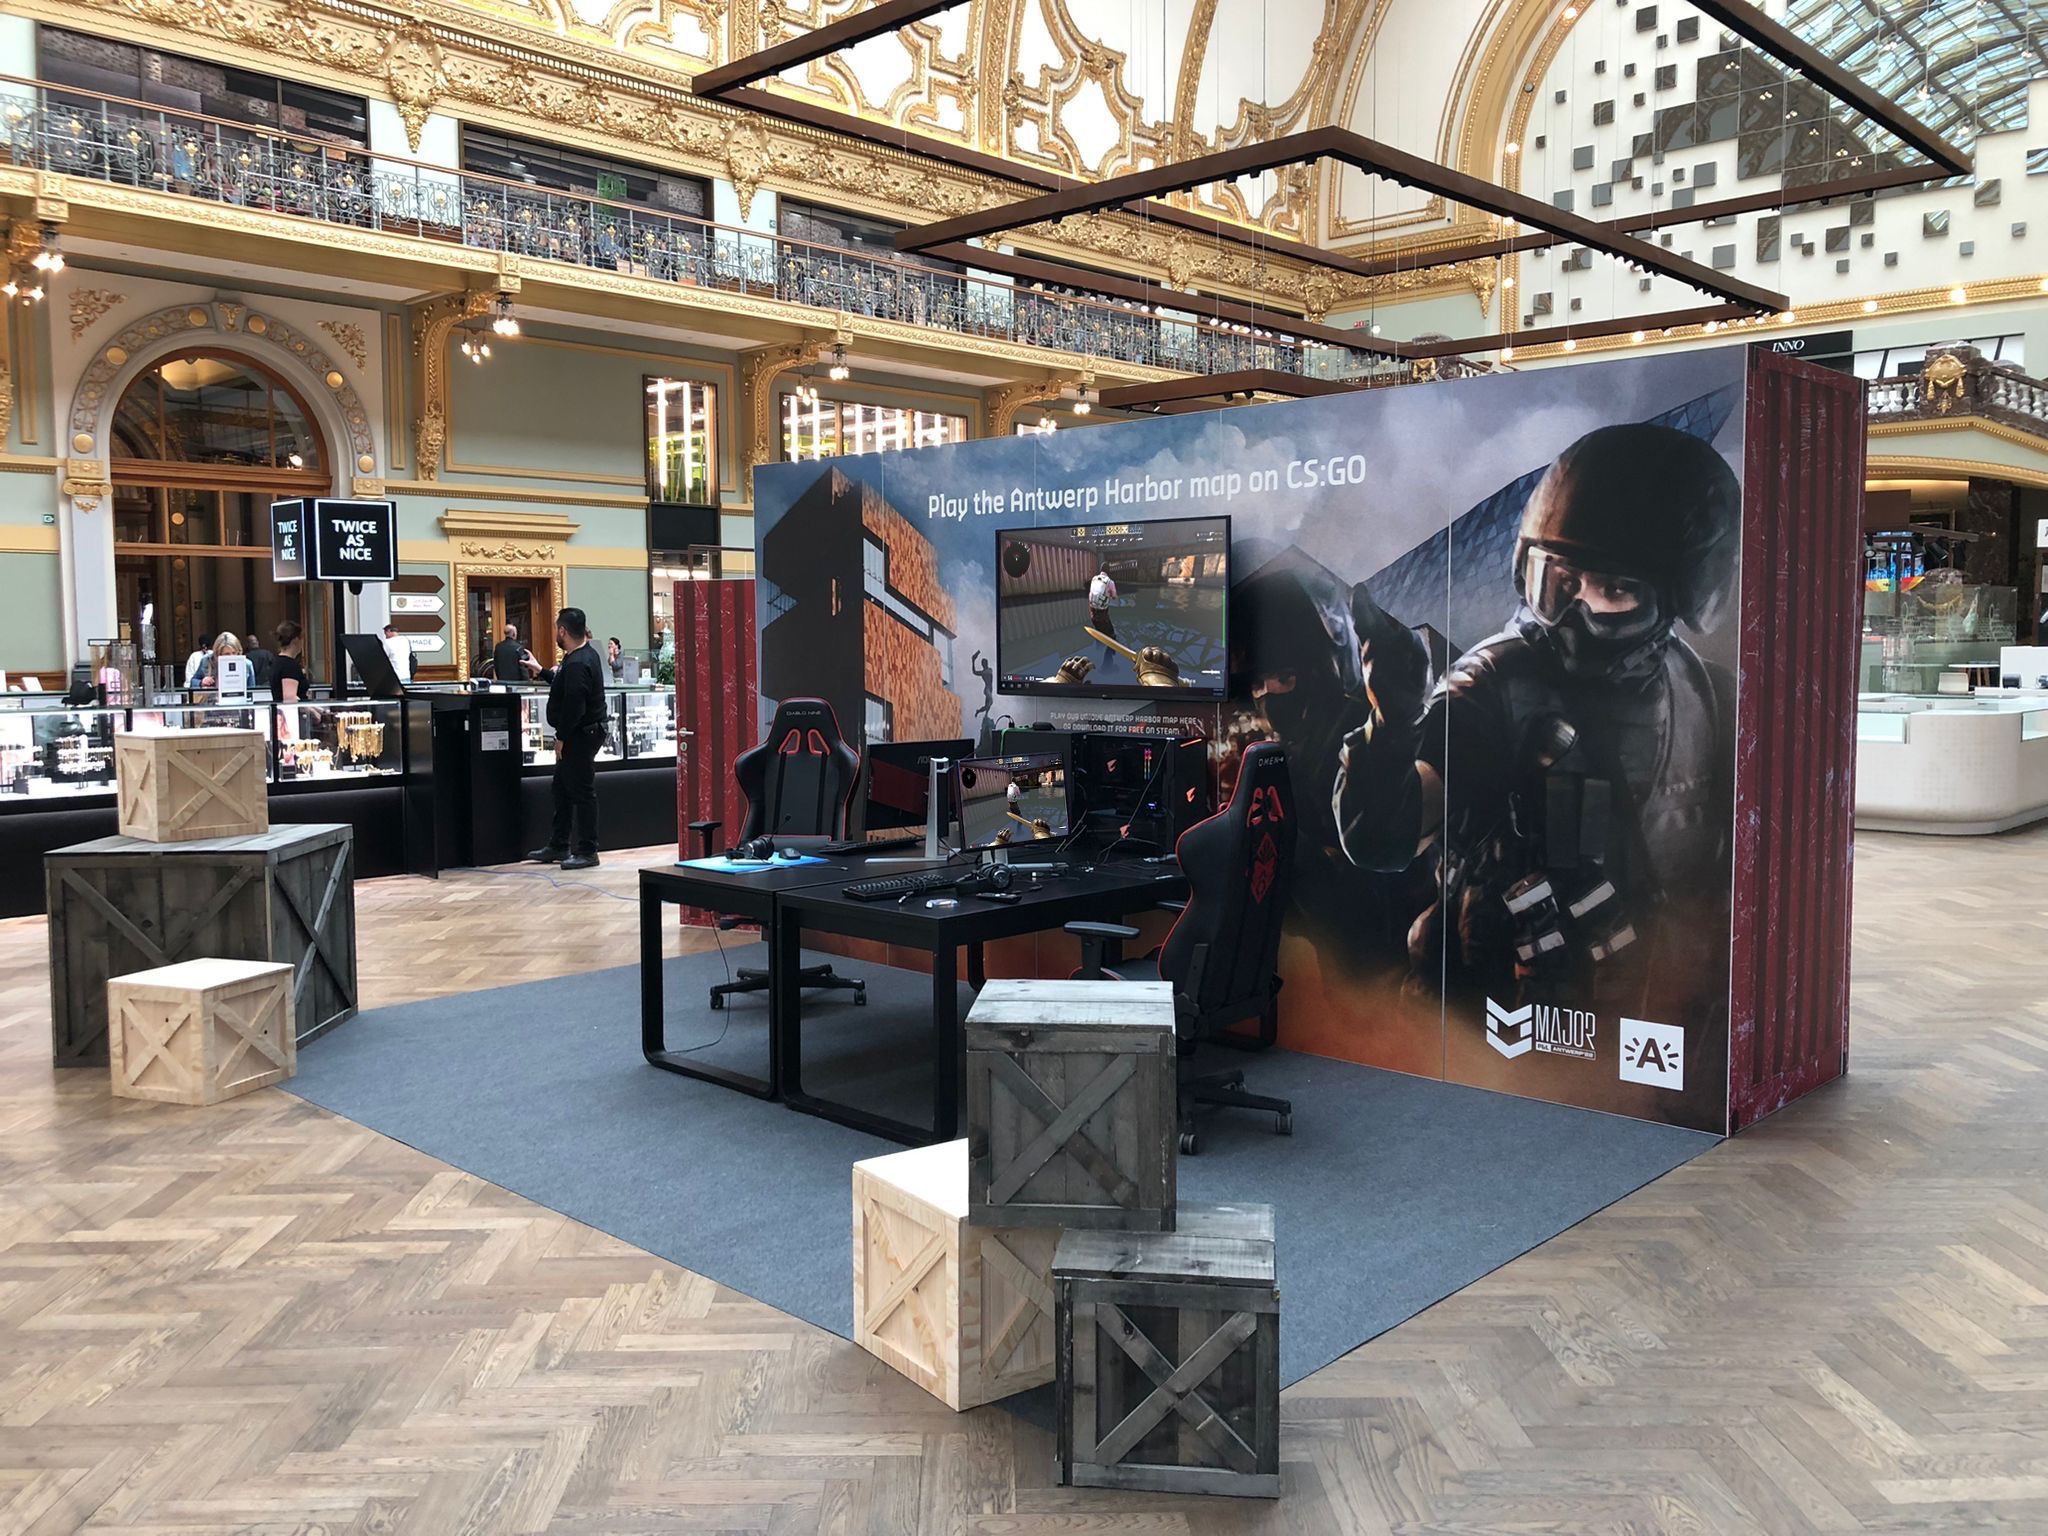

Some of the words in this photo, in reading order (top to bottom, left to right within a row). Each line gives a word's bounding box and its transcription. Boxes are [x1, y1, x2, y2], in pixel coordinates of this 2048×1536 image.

[1772, 339, 1805, 352] INNO
[928, 493, 968, 522] Play
[973, 489, 1004, 516] the
[1010, 487, 1098, 513] Antwerp
[1105, 474, 1182, 505] Harbor
[1190, 472, 1241, 501] map
[1249, 469, 1278, 493] on
[1286, 454, 1366, 489] CS:GO
[277, 520, 298, 533] TWICE
[331, 519, 378, 534] TWICE
[284, 535, 293, 547] AS
[346, 534, 365, 547] AS
[281, 549, 296, 560] NICE
[339, 548, 372, 560] NICE
[1067, 712, 1080, 720] OUR
[1104, 713, 1134, 722] ANTWERP
[1135, 715, 1161, 723] HARBOR
[1163, 716, 1178, 724] MAP
[1072, 723, 1106, 732] DOWNLOAD
[1535, 1004, 1596, 1050] MAJOR
[1636, 1037, 1667, 1072] A
